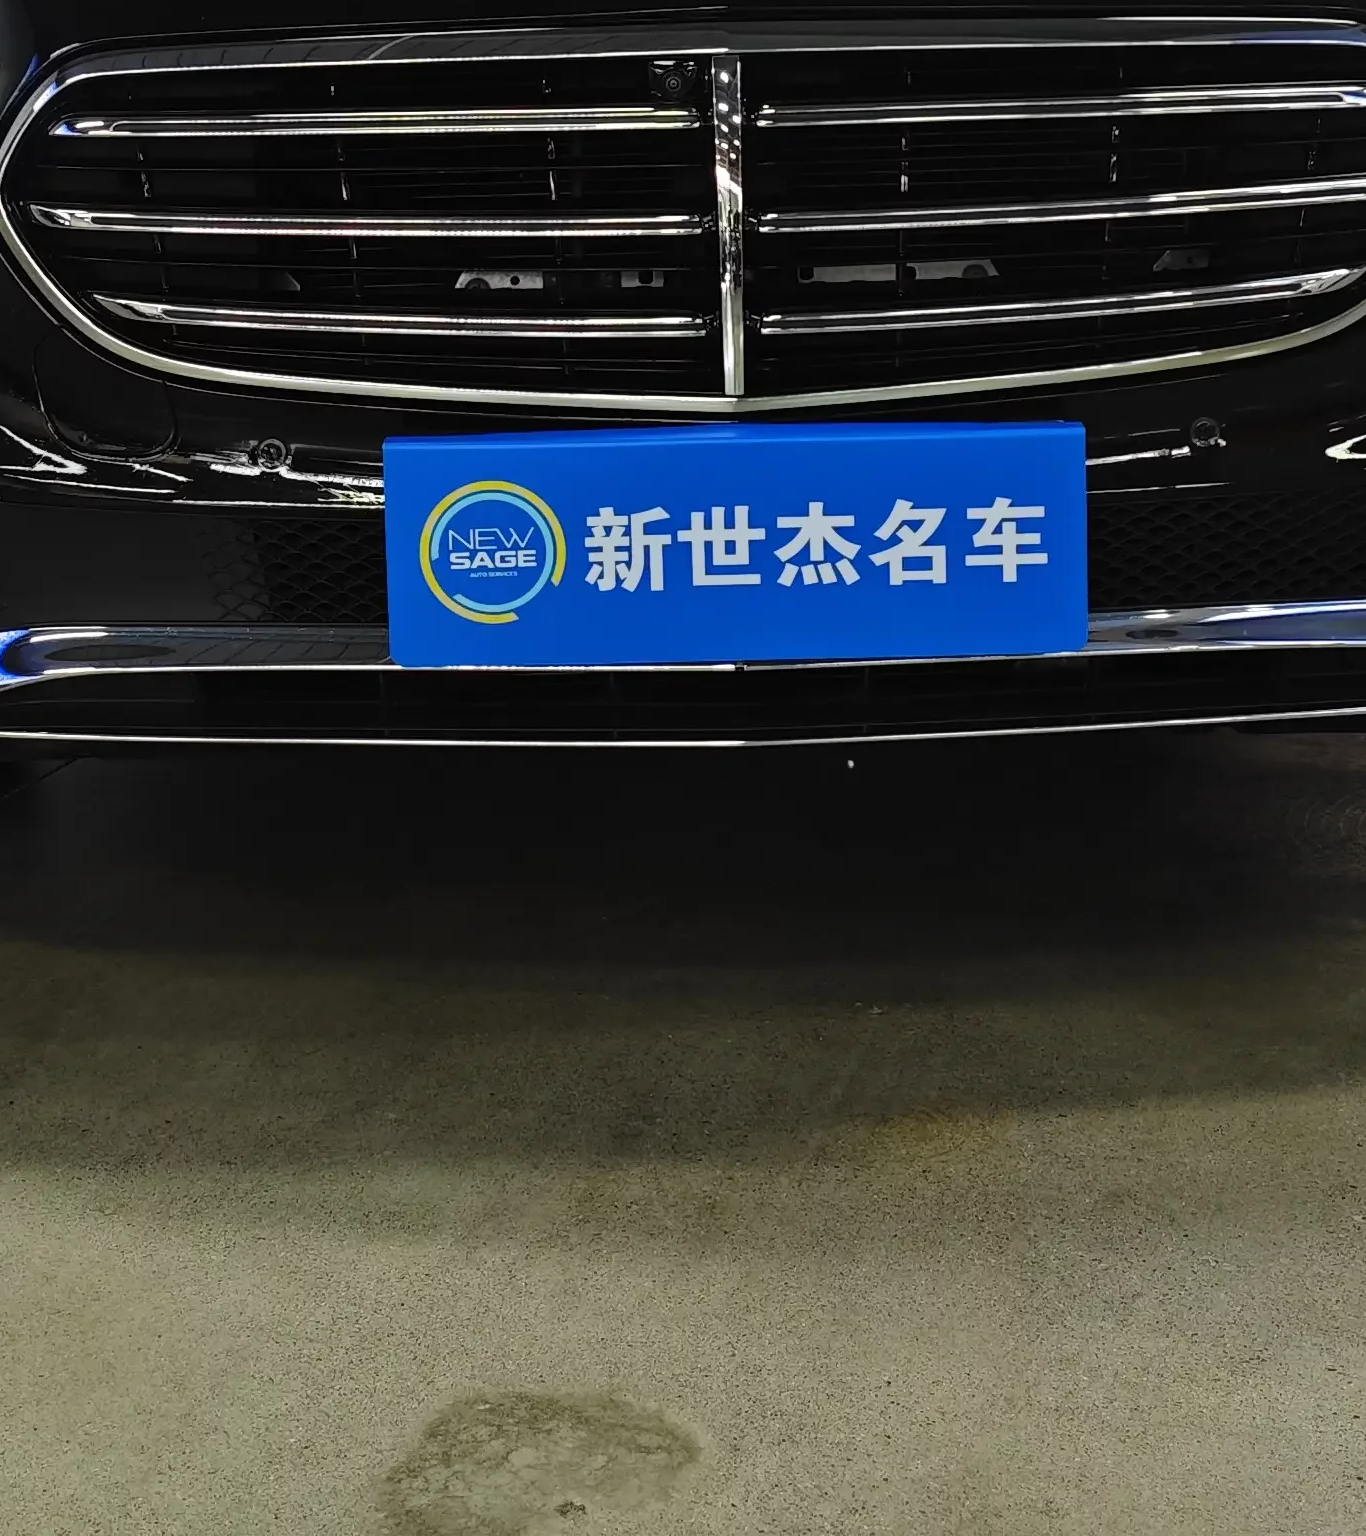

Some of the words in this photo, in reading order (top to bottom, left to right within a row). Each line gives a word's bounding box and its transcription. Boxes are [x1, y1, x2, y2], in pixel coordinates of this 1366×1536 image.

[448, 526, 535, 551] NEW
[584, 496, 1050, 593] 新世杰名车
[449, 549, 538, 570] SAGE
